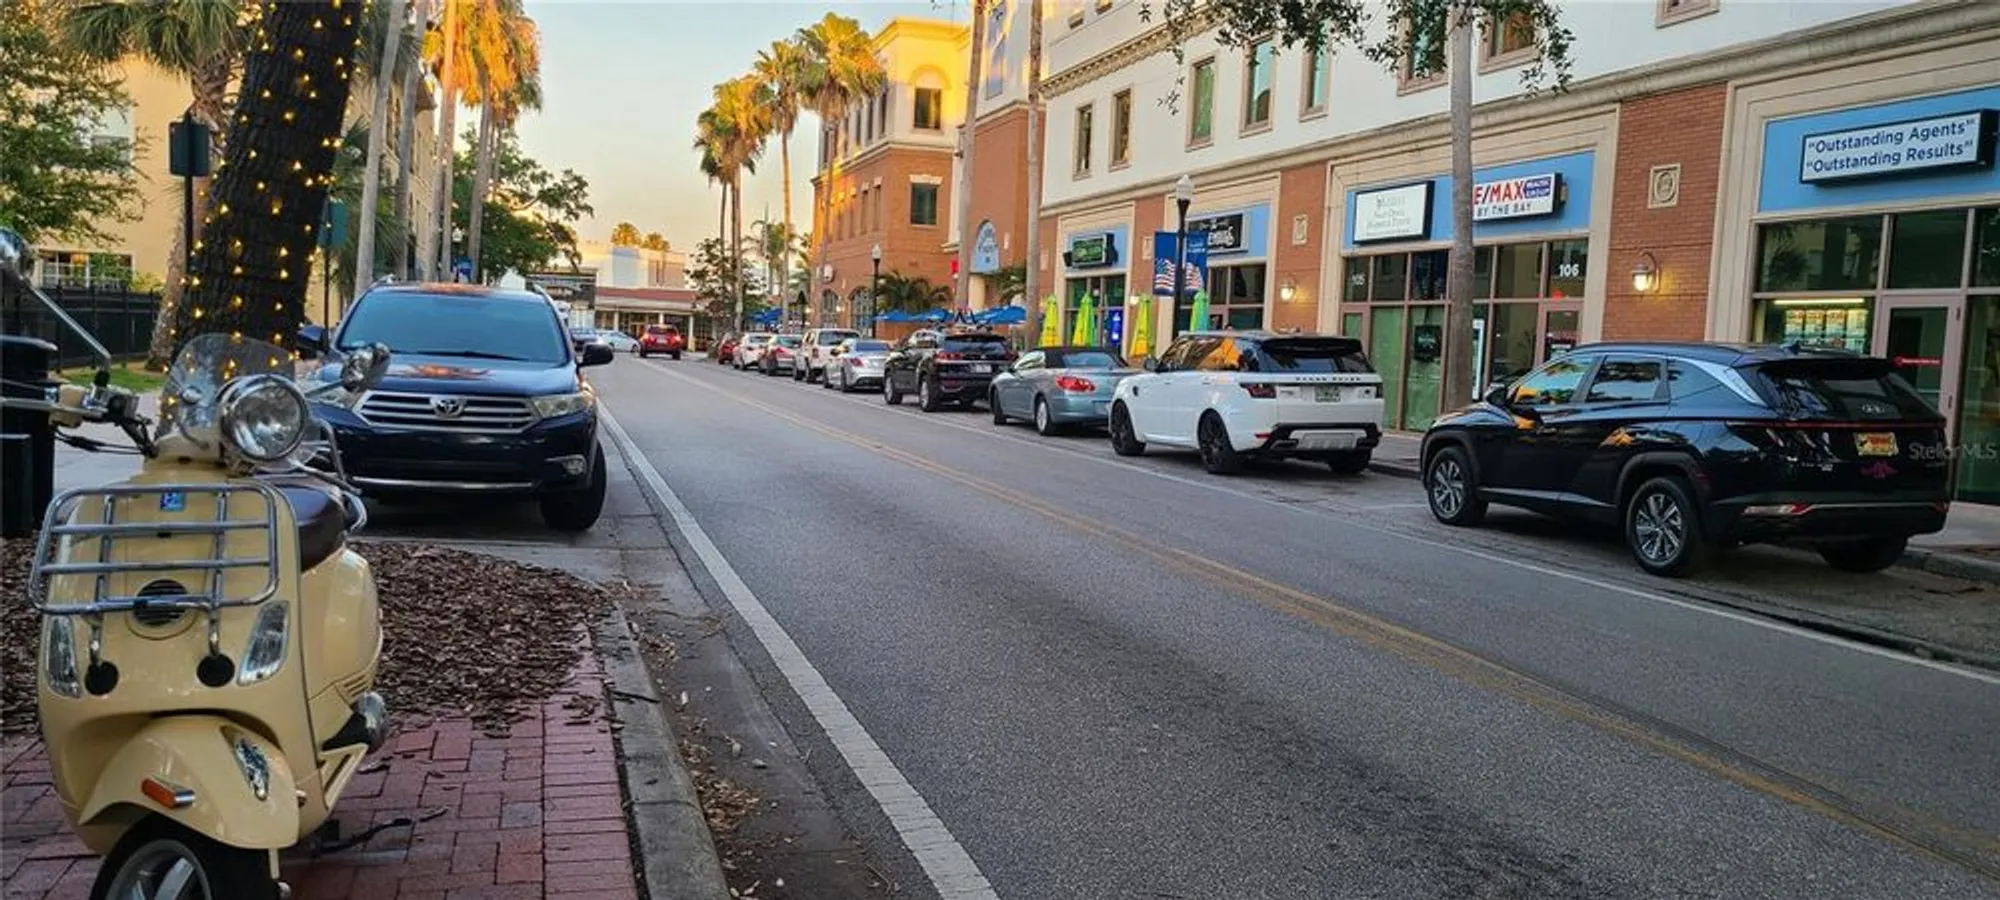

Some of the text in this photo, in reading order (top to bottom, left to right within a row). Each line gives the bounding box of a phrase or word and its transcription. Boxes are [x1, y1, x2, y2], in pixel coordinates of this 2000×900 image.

[1473, 180, 1524, 206] E/MAX
[1477, 202, 1531, 217] BY THE BAY
[1559, 264, 1579, 277] 106
